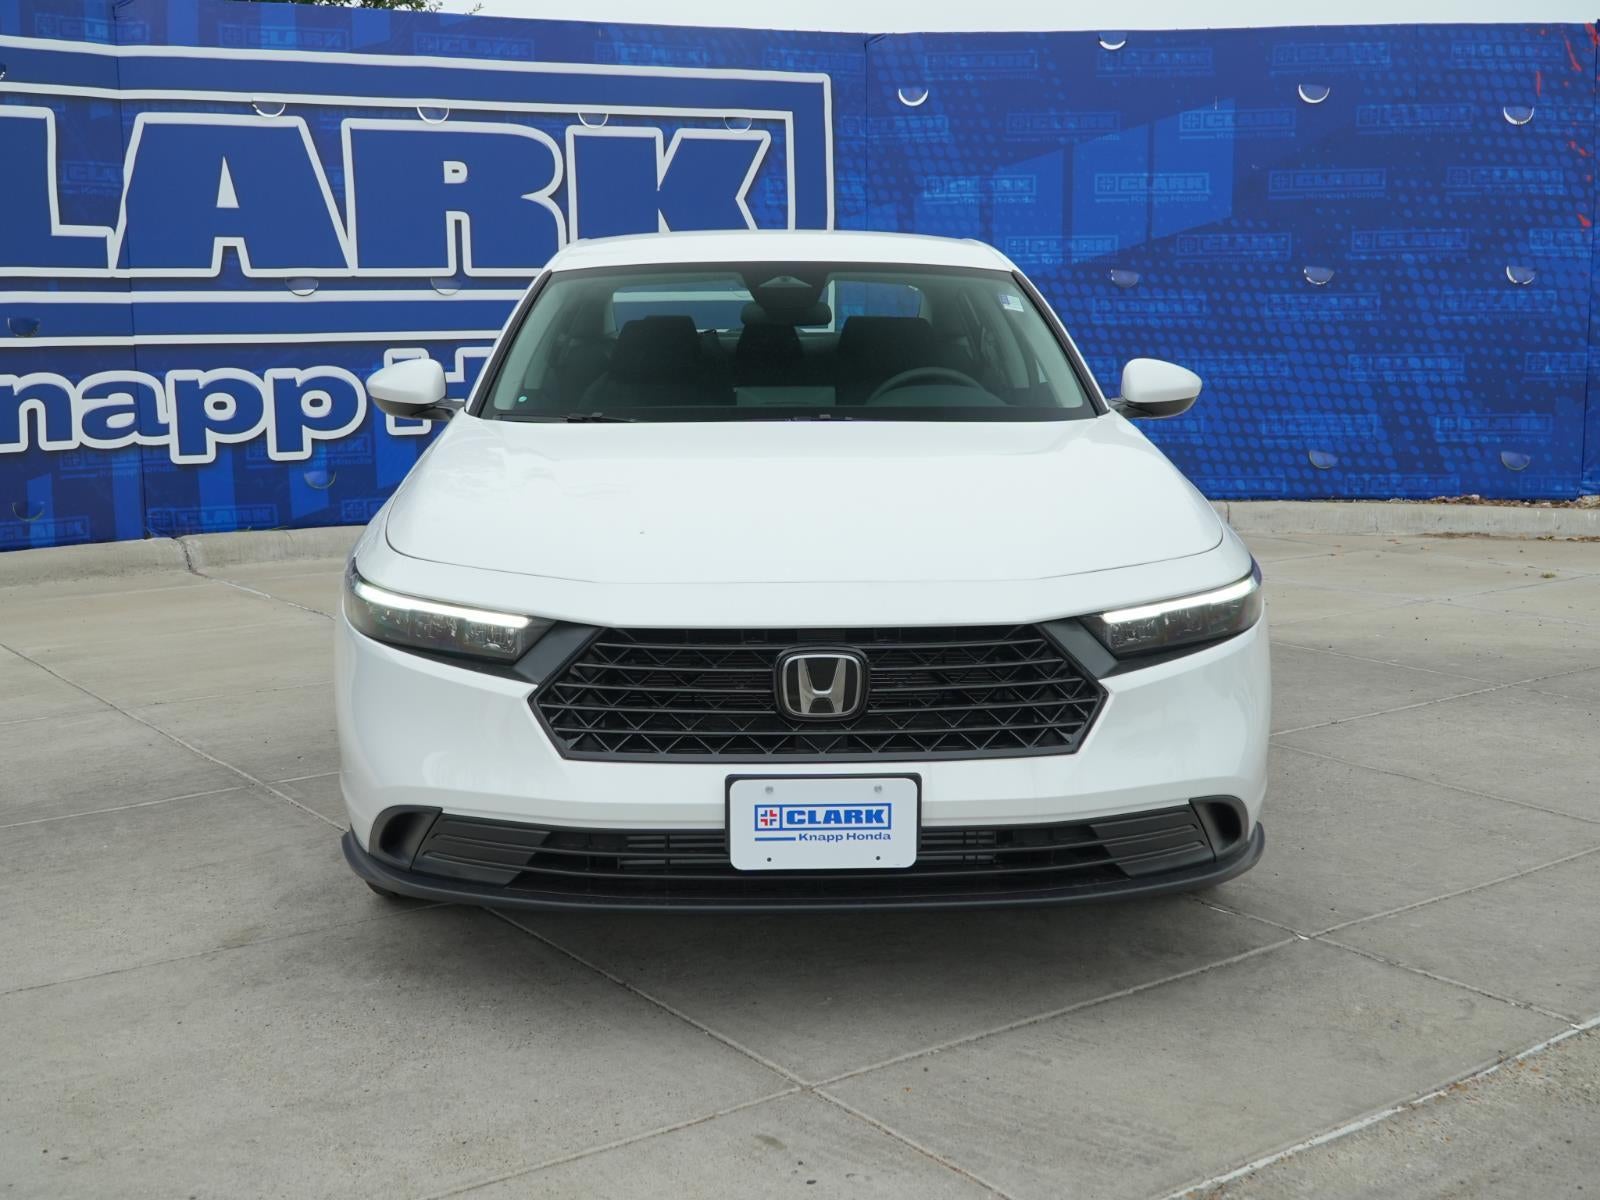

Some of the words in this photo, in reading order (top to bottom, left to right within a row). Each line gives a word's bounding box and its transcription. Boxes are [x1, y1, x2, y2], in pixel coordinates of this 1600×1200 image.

[786, 809, 885, 825] CLARK
[798, 833, 844, 843] Knapp
[846, 831, 892, 841] Honda
